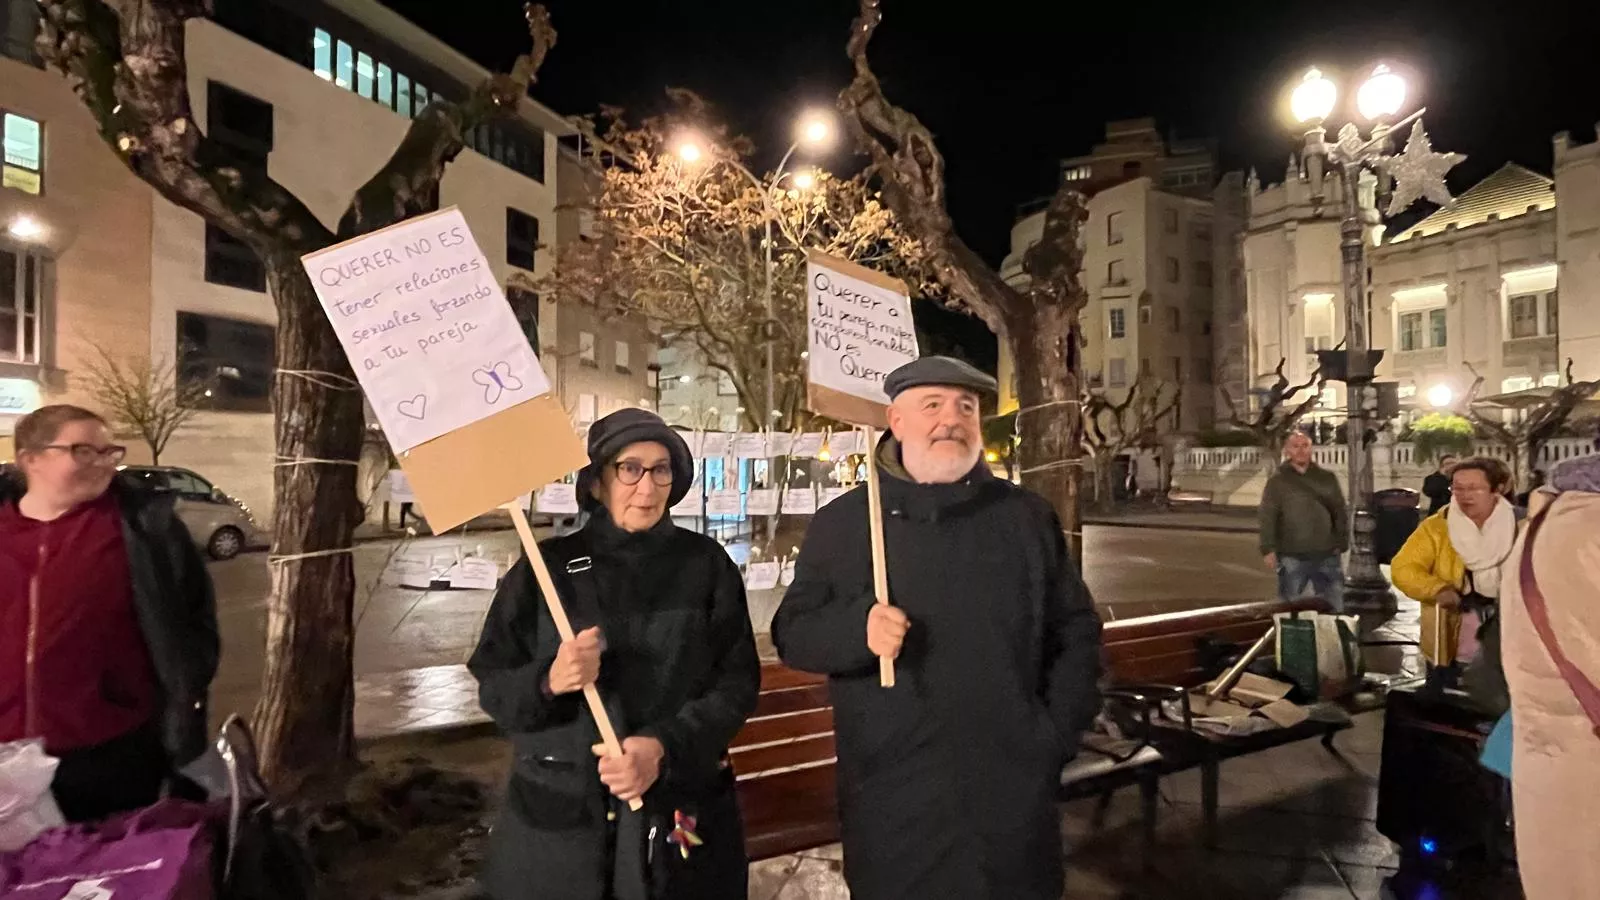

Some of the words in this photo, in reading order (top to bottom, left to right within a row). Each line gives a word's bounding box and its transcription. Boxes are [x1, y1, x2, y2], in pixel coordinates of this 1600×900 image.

[319, 248, 399, 287] QUERER
[404, 238, 432, 260] NO
[438, 226, 465, 248] ES
[333, 291, 382, 317] tener
[395, 257, 481, 296] relaciones
[814, 273, 881, 310] Querer
[888, 308, 899, 317] a
[817, 295, 833, 318] tu
[351, 310, 422, 345] sexuales
[429, 284, 492, 322] forzando
[815, 329, 840, 351] NO
[363, 357, 381, 371] a
[380, 345, 409, 360] tu
[418, 320, 479, 355] pareja
